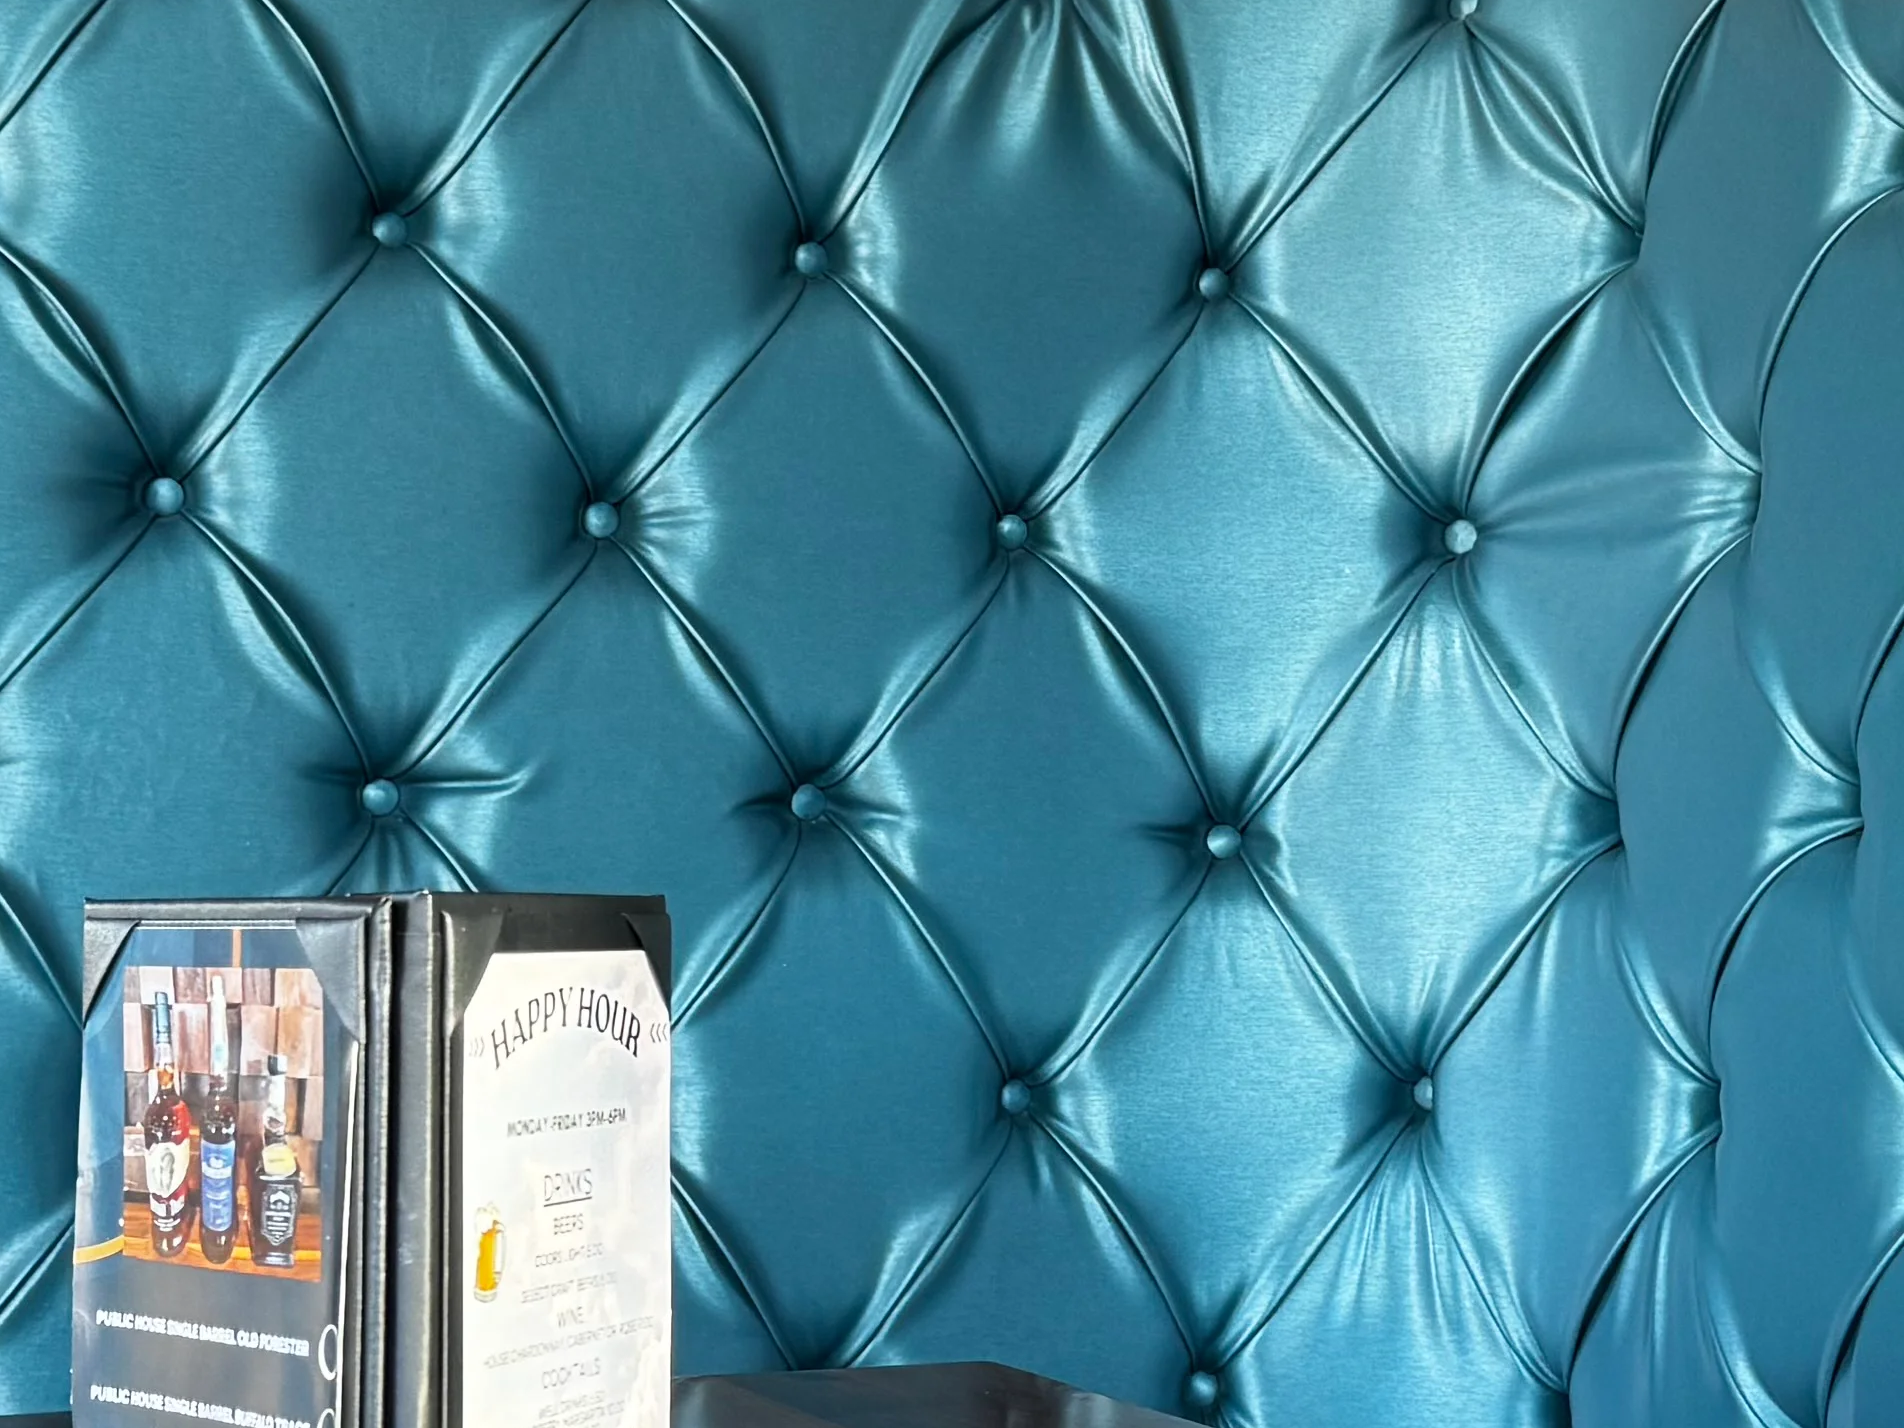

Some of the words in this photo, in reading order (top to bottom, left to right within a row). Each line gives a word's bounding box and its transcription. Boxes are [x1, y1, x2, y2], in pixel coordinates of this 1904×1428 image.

[491, 987, 573, 1070] HAPPY
[577, 987, 641, 1058] HOUR
[586, 1107, 627, 1128] 3PM-6PM
[543, 1168, 593, 1202] DRINKS
[552, 1213, 584, 1236] BEERS
[96, 1309, 134, 1330] PUBLIC
[134, 1313, 166, 1335] HOUSE
[167, 1319, 198, 1340] SINGLE
[199, 1324, 236, 1346] BARREL
[237, 1330, 259, 1349] OLD
[259, 1333, 310, 1357] FORESTER
[556, 1306, 585, 1329] WINE
[541, 1357, 601, 1389] COCKTAILS
[90, 1384, 130, 1405] PUBLIC
[130, 1390, 164, 1411] HOUSE
[164, 1395, 198, 1417] SINGLE
[198, 1401, 234, 1424] BARREL
